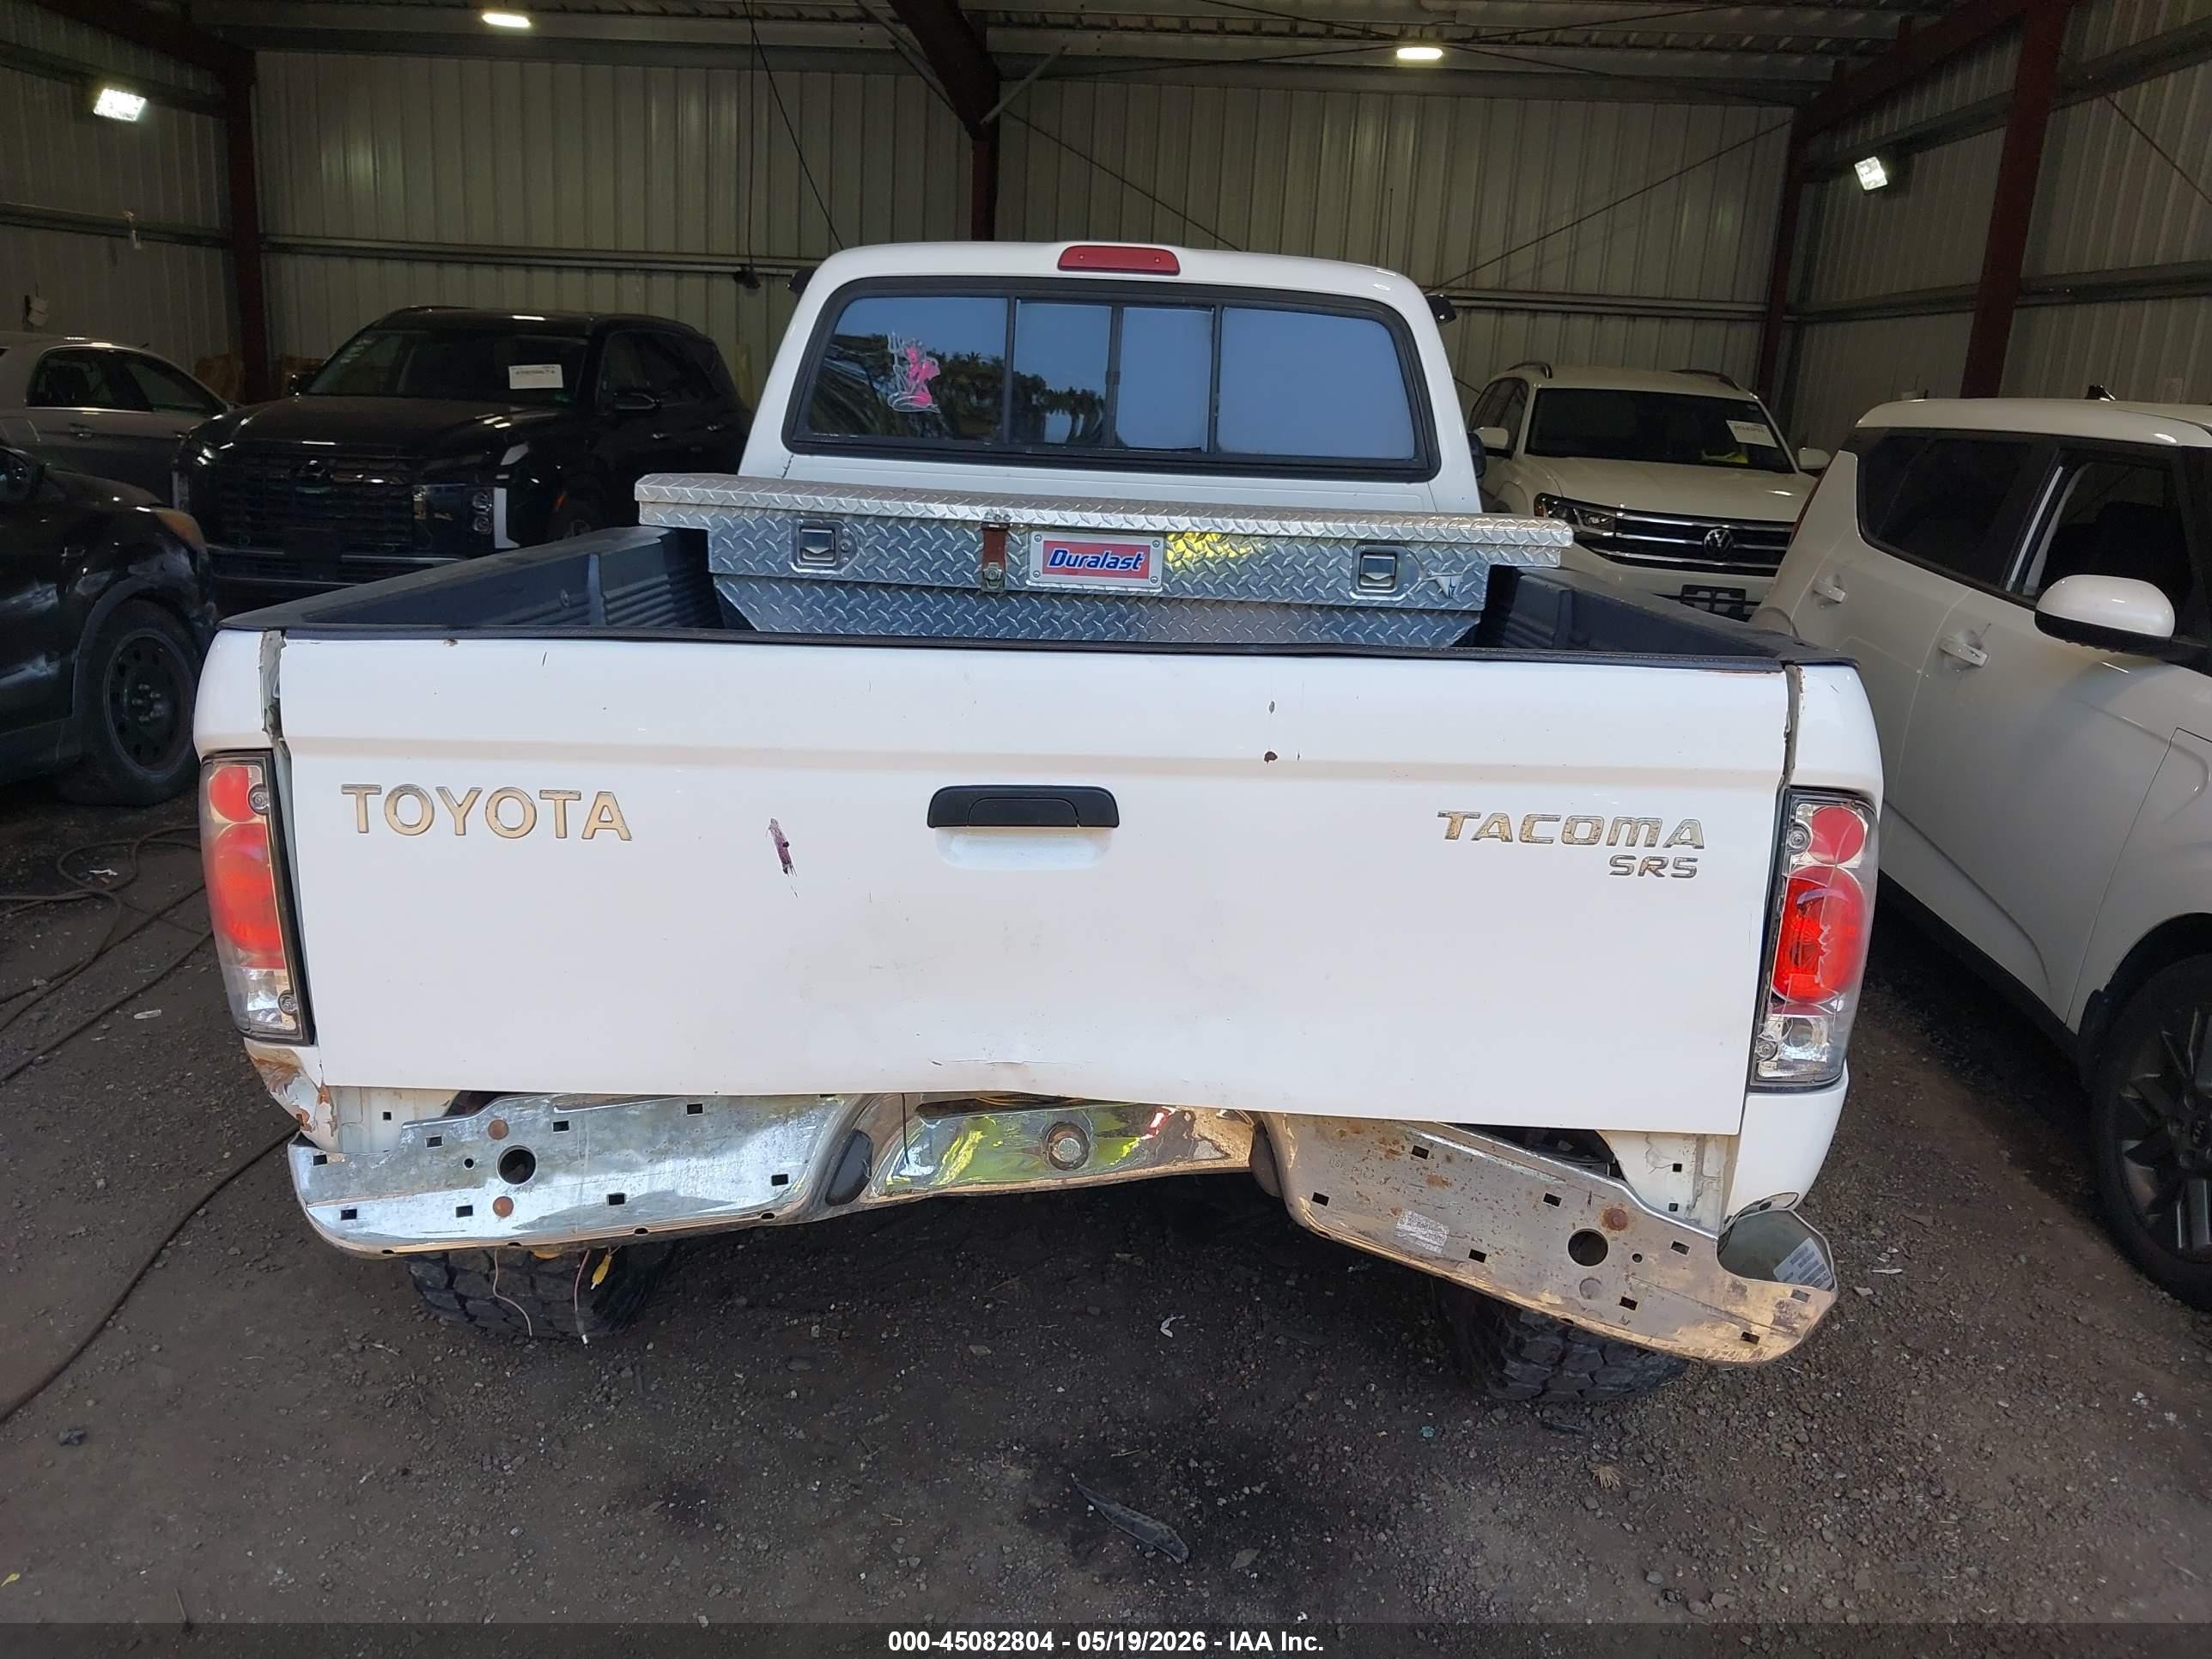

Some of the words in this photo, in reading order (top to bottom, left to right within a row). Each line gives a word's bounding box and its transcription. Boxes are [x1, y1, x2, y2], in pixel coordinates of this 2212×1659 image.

[1048, 548, 1146, 572] Duralast
[341, 782, 633, 842] TOYOTA
[1437, 810, 1706, 850] TACOMA
[1608, 854, 1698, 878] SR5
